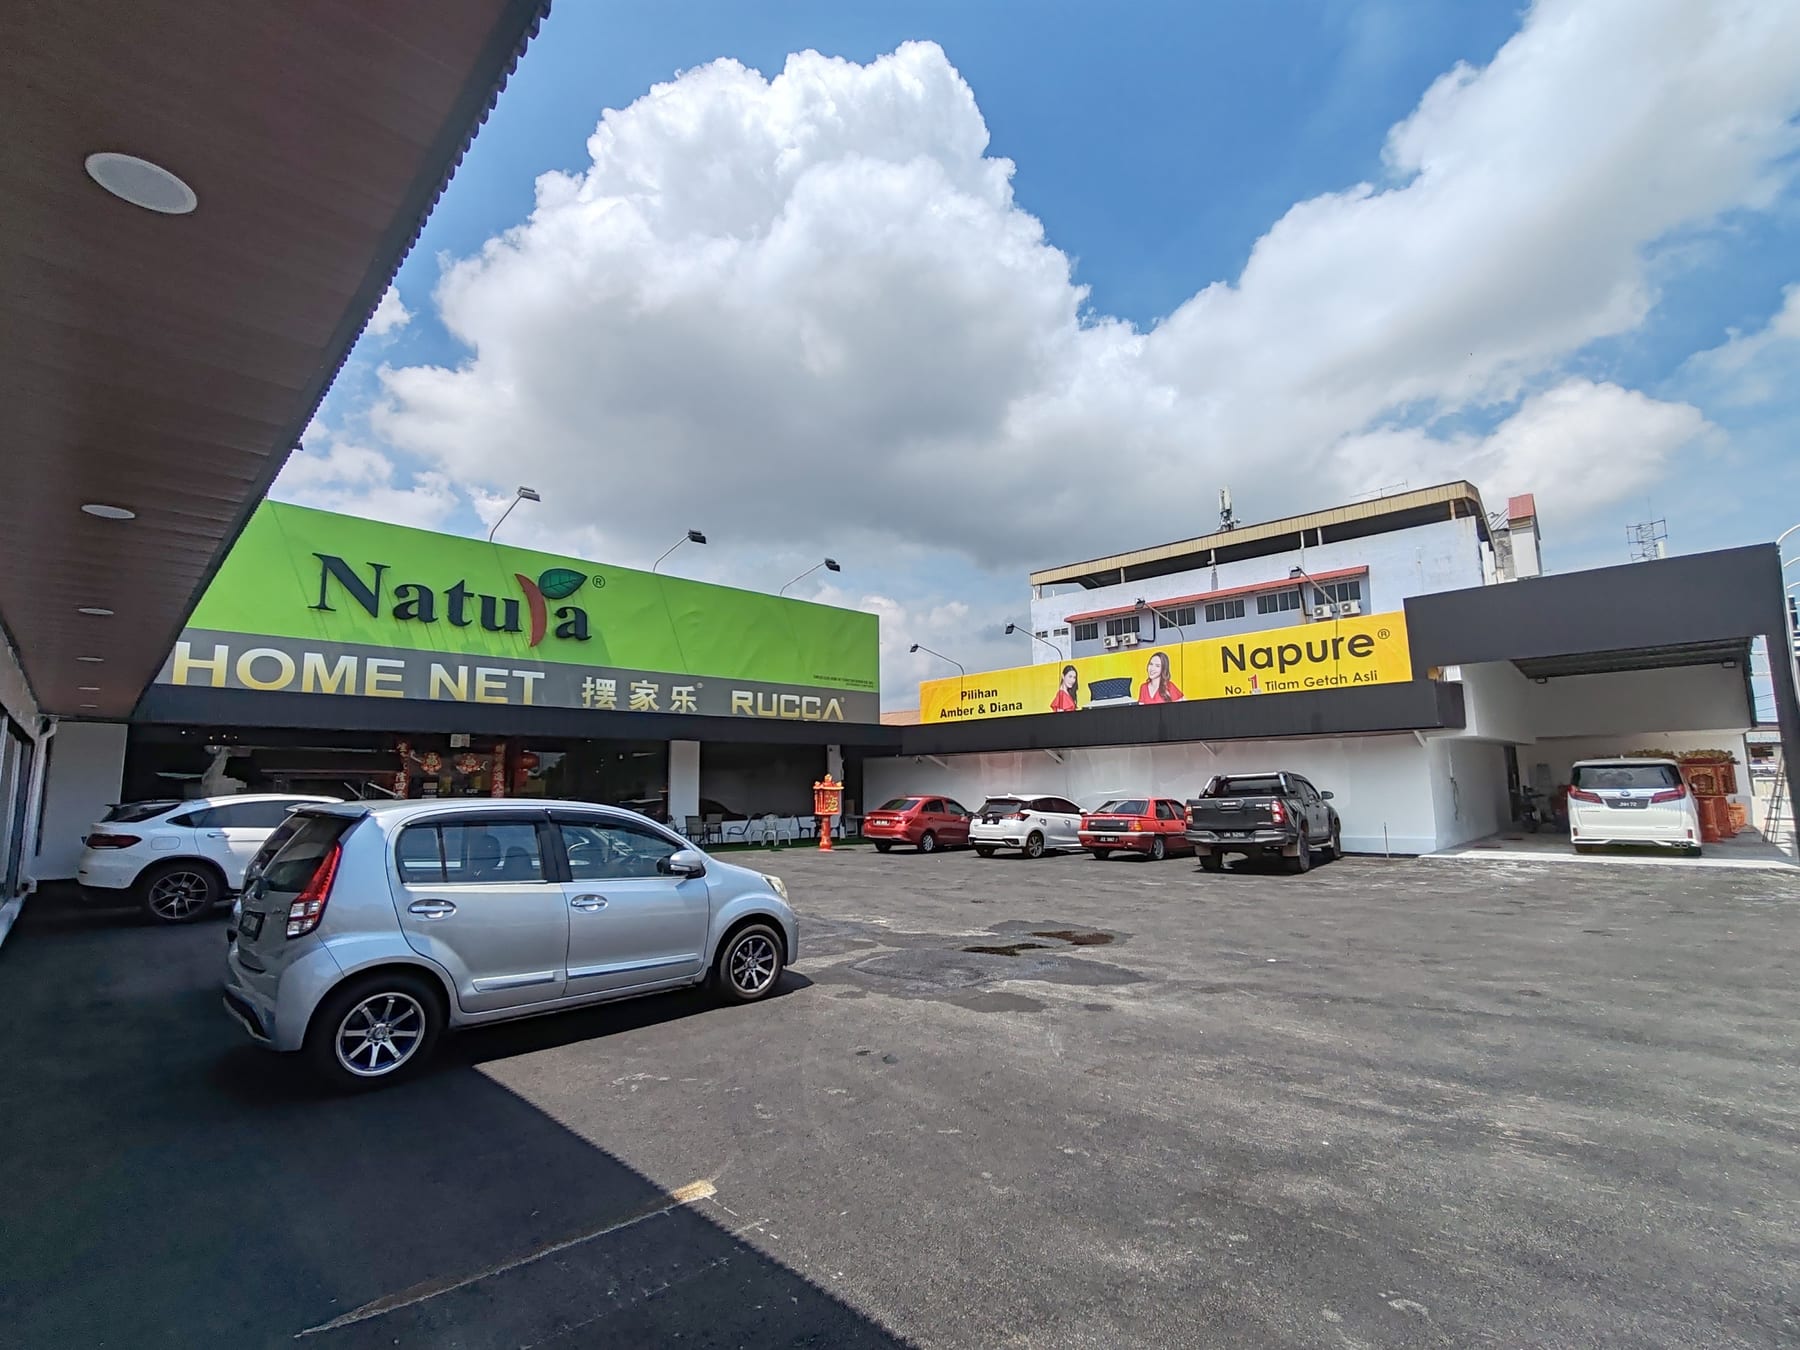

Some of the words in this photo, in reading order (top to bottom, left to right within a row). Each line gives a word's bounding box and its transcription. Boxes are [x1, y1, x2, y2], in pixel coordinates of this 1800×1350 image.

[1220, 633, 1375, 674] Napure
[171, 641, 406, 698] HOME
[429, 662, 546, 705] NET
[1224, 685, 1246, 696] No.
[1265, 680, 1300, 692] Tilam
[1303, 673, 1348, 688] Getah
[1352, 669, 1378, 683] Asli
[581, 676, 698, 714] 摆家乐
[731, 689, 845, 721] RUCCA
[940, 706, 974, 719] Amber
[977, 703, 986, 714] &
[990, 701, 1023, 713] Diana
[960, 688, 998, 701] Pilihan
